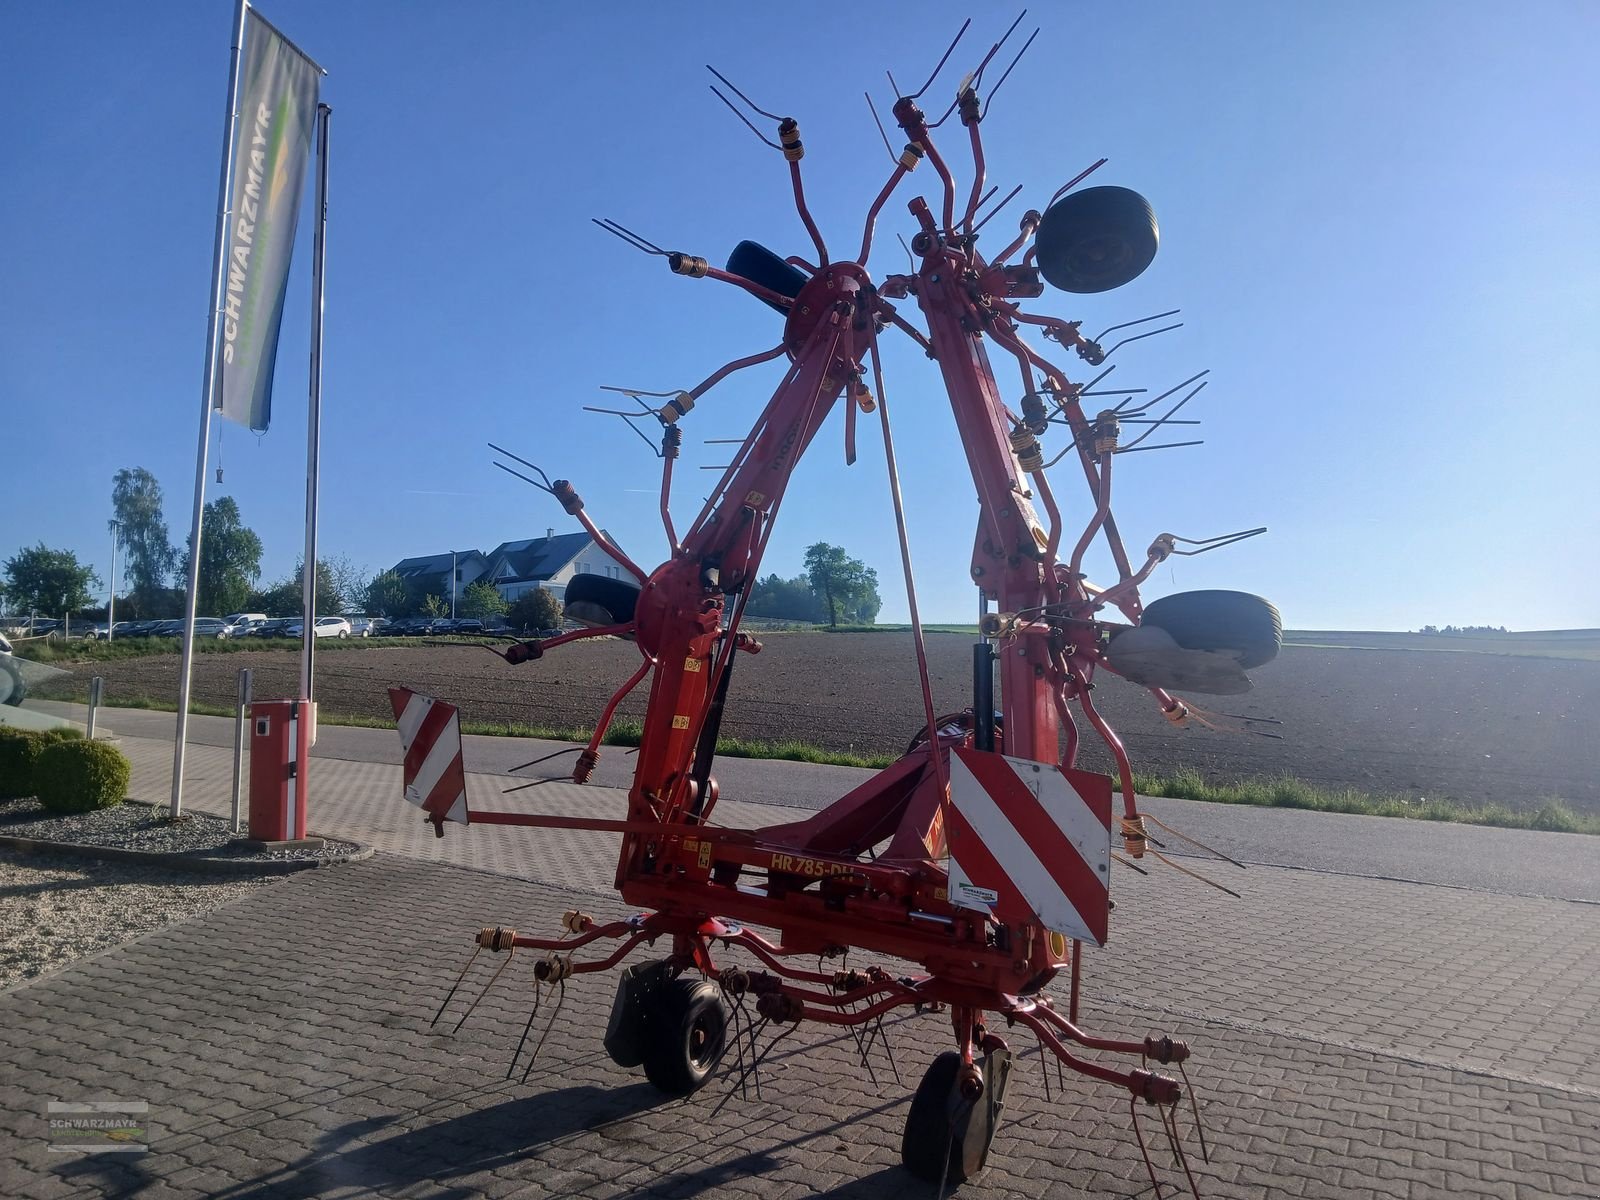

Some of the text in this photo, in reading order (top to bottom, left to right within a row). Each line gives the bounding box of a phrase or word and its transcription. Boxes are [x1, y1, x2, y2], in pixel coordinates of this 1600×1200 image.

[223, 104, 272, 363] SCHWARZMAYR
[771, 854, 854, 882] HR 785-DH
